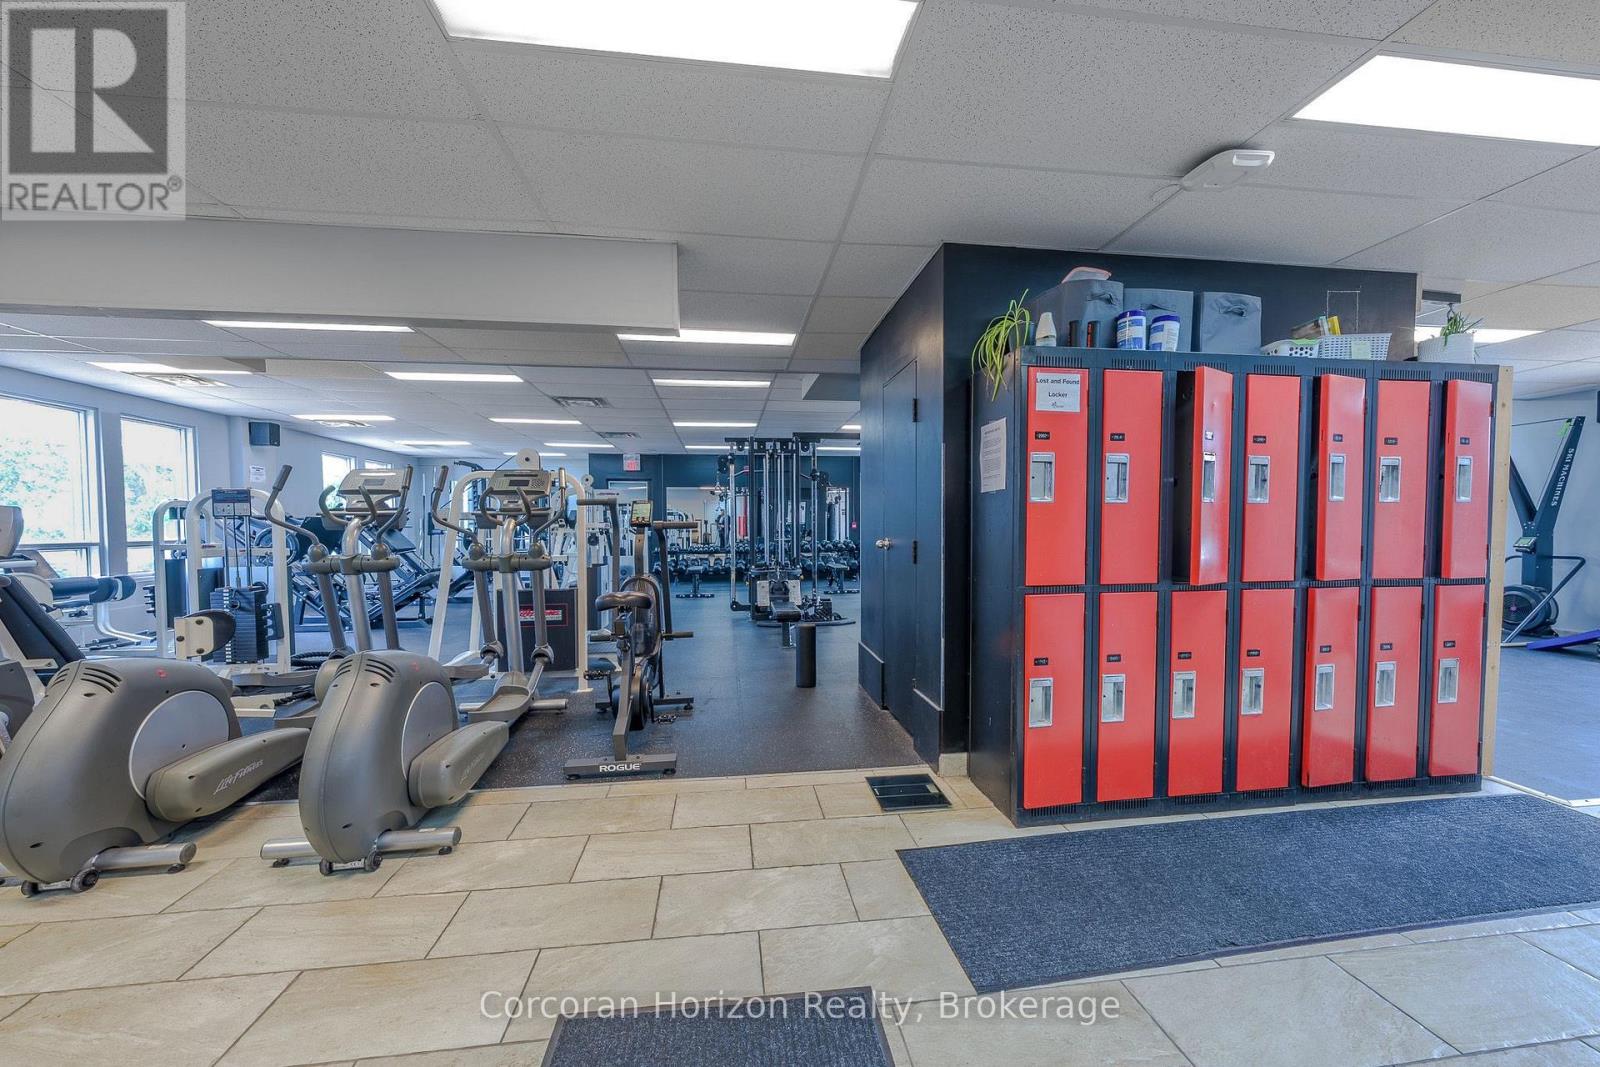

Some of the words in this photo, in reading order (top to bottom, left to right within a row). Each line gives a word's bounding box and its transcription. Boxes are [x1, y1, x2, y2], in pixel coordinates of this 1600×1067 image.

[1565, 448, 1575, 463] SKI
[1551, 464, 1572, 507] MACHINES
[599, 763, 641, 773] ROGUE
